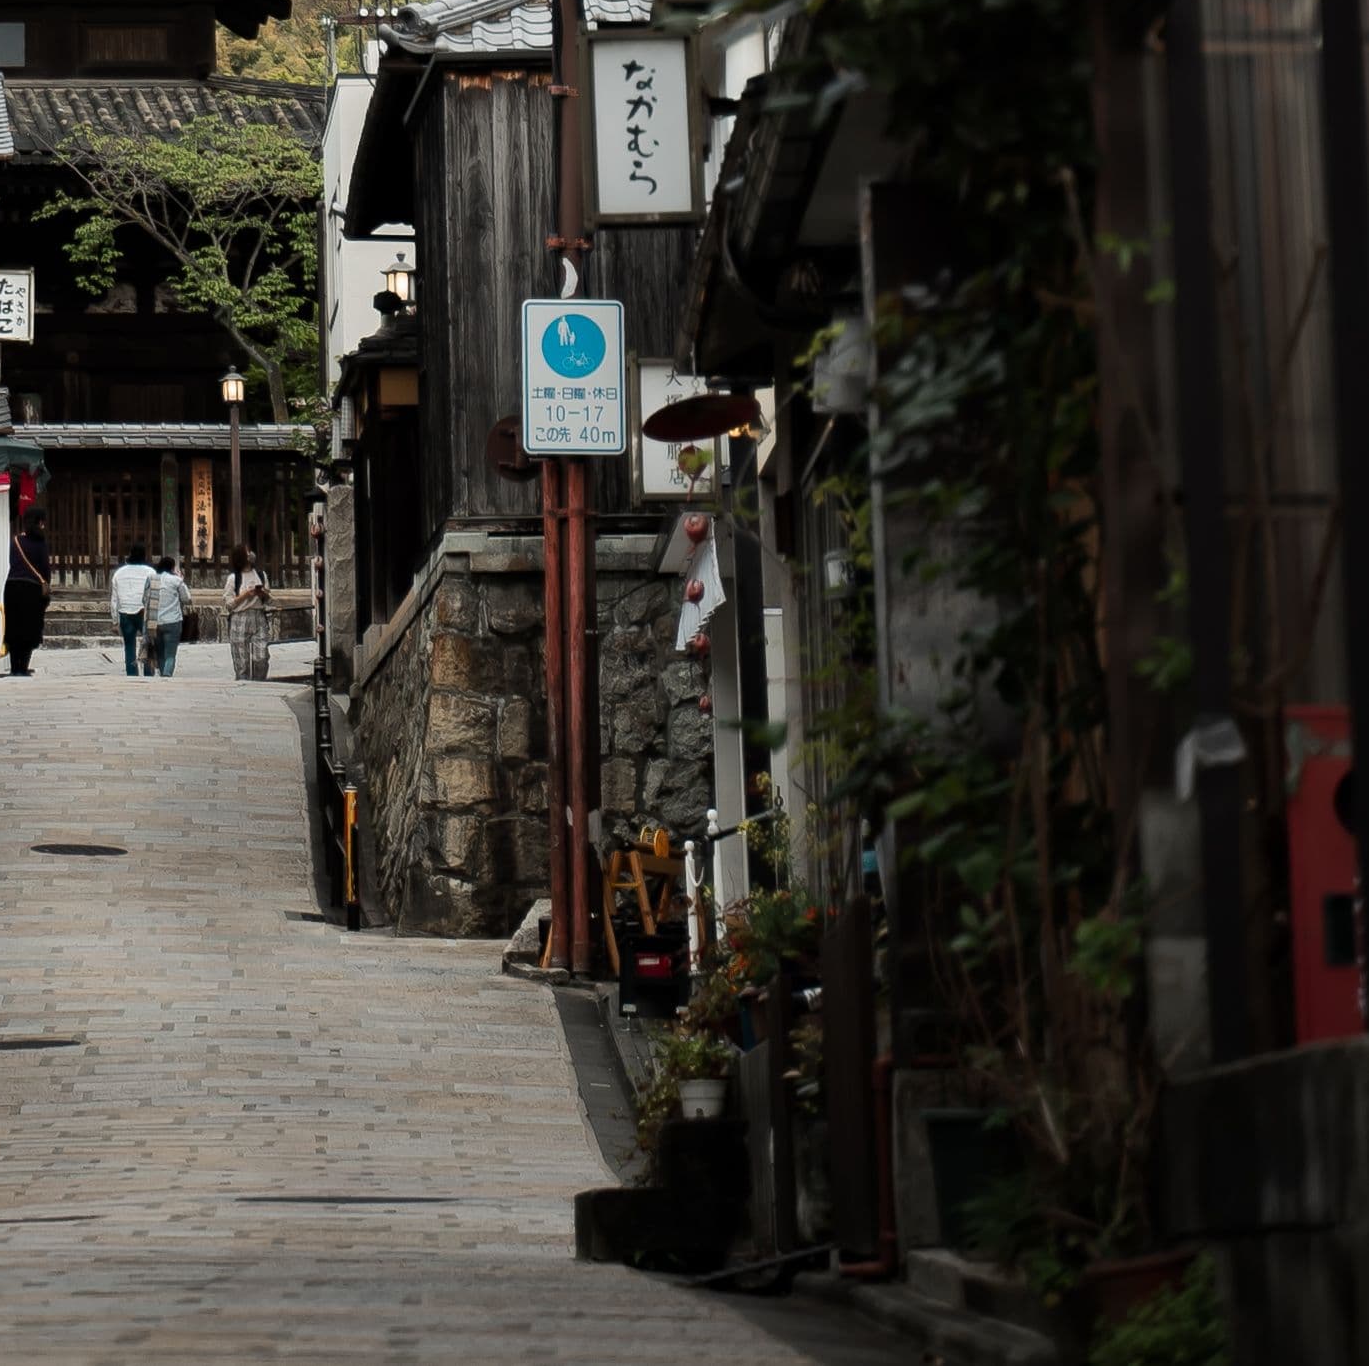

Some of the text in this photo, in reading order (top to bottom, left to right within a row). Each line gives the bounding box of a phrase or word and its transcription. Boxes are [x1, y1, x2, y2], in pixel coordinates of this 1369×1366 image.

[621, 59, 660, 196] なかむら
[15, 286, 26, 327] やさか
[534, 426, 616, 444] この先 40m
